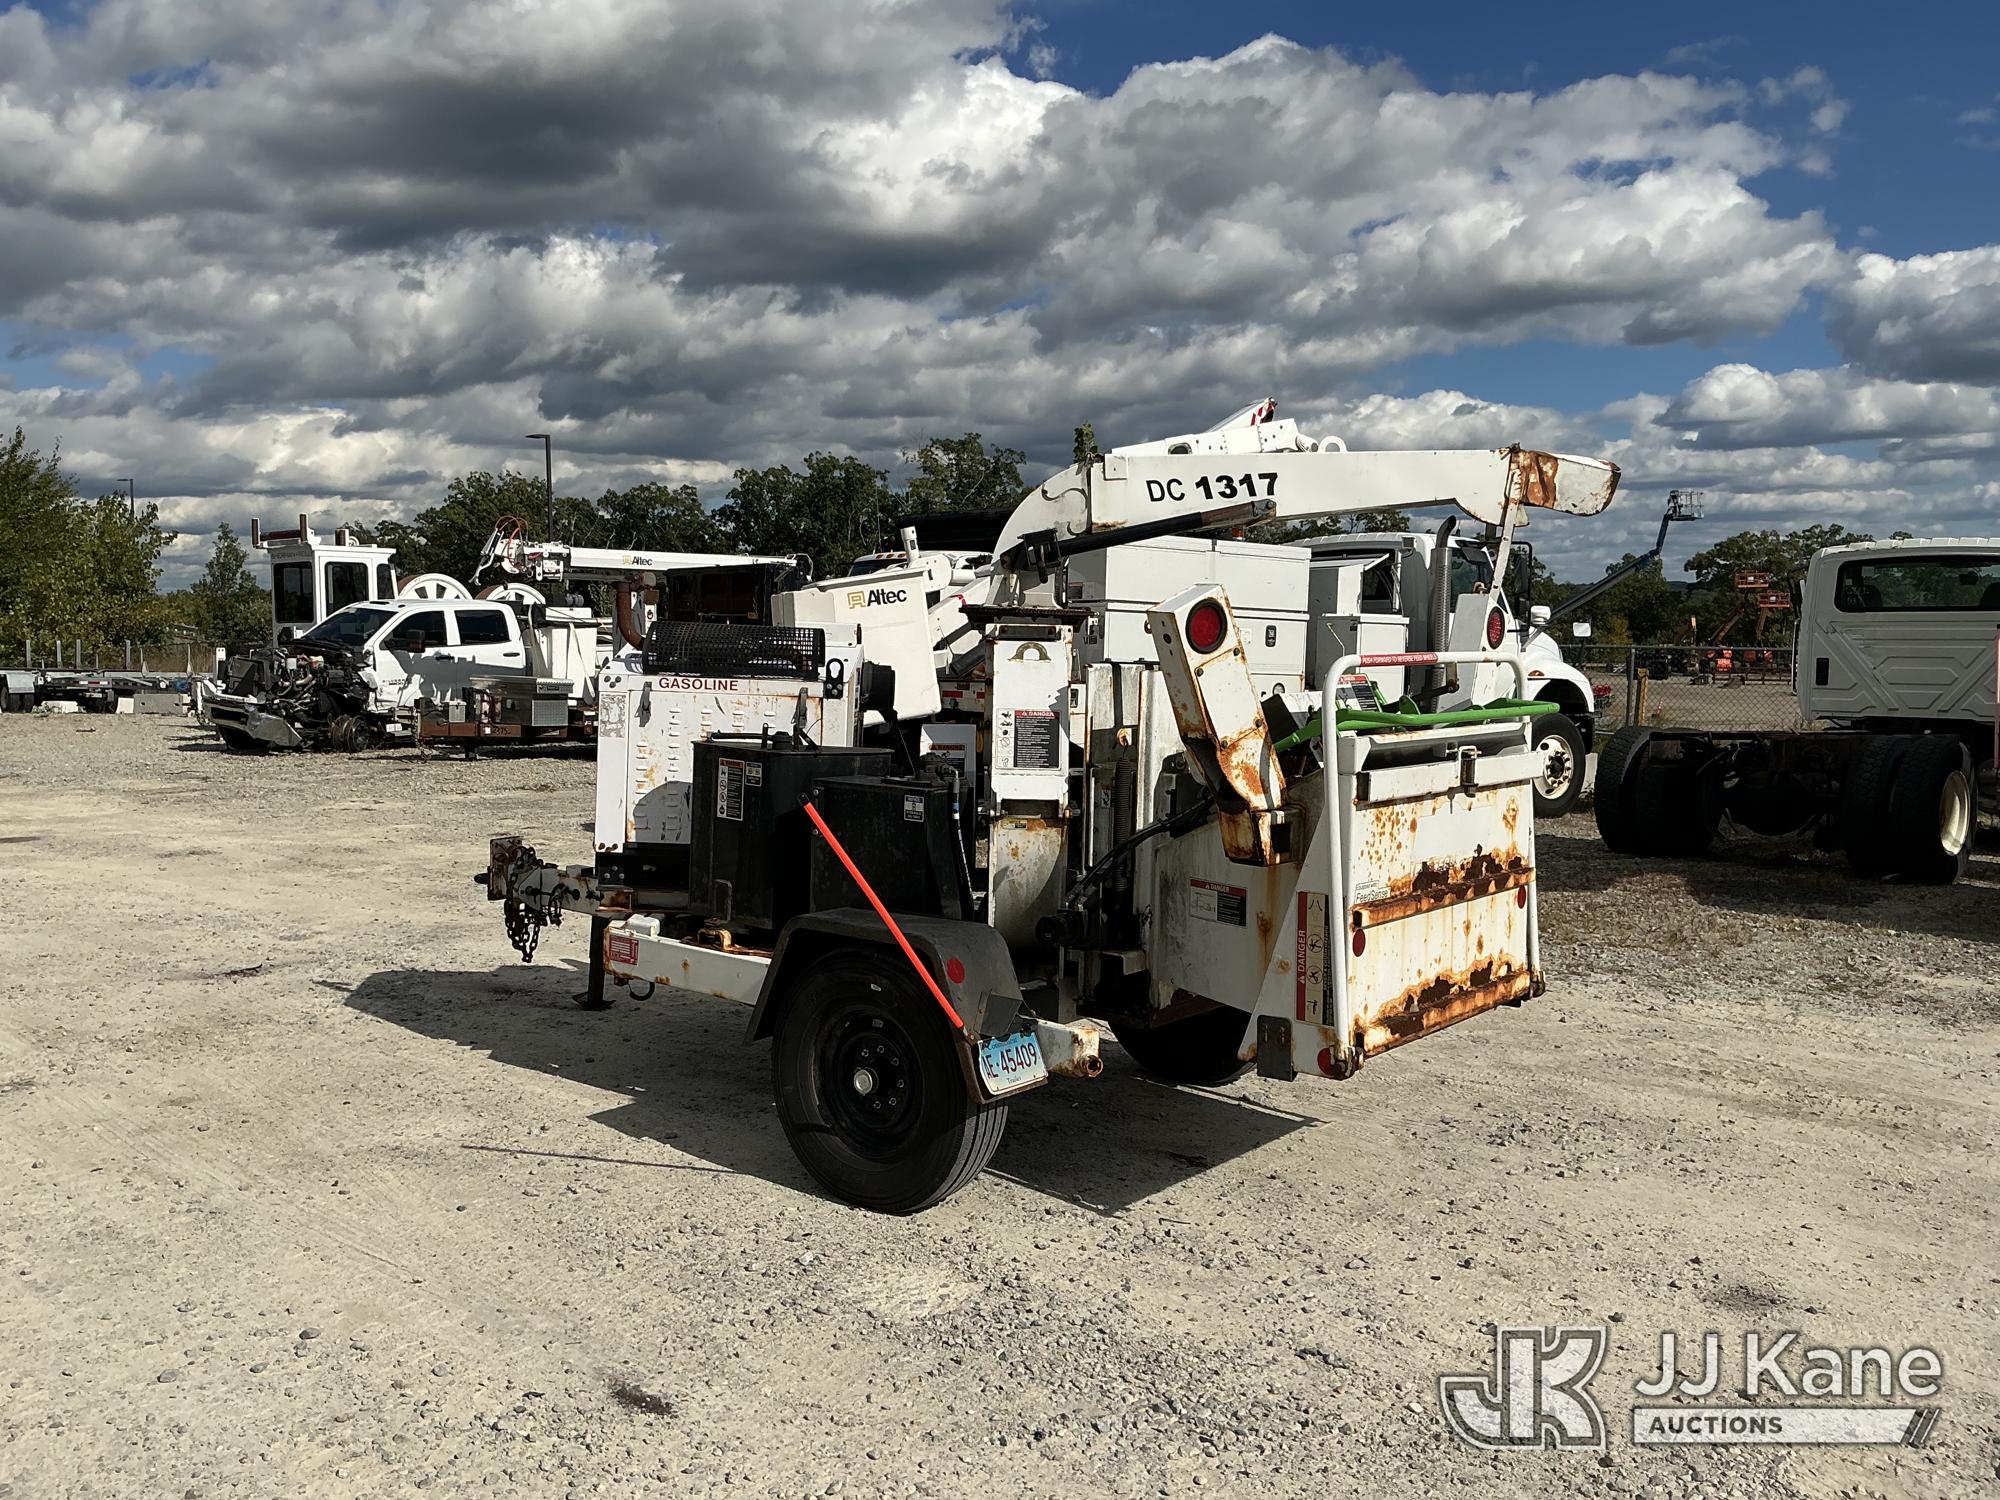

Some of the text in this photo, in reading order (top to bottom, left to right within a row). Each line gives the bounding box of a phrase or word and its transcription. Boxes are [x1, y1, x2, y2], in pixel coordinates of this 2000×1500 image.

[1145, 472, 1278, 502] DC 1317
[632, 555, 653, 566] Altec
[866, 588, 907, 607] Altec
[658, 677, 739, 691] GASOLINE
[1298, 930, 1306, 973] DANGER
